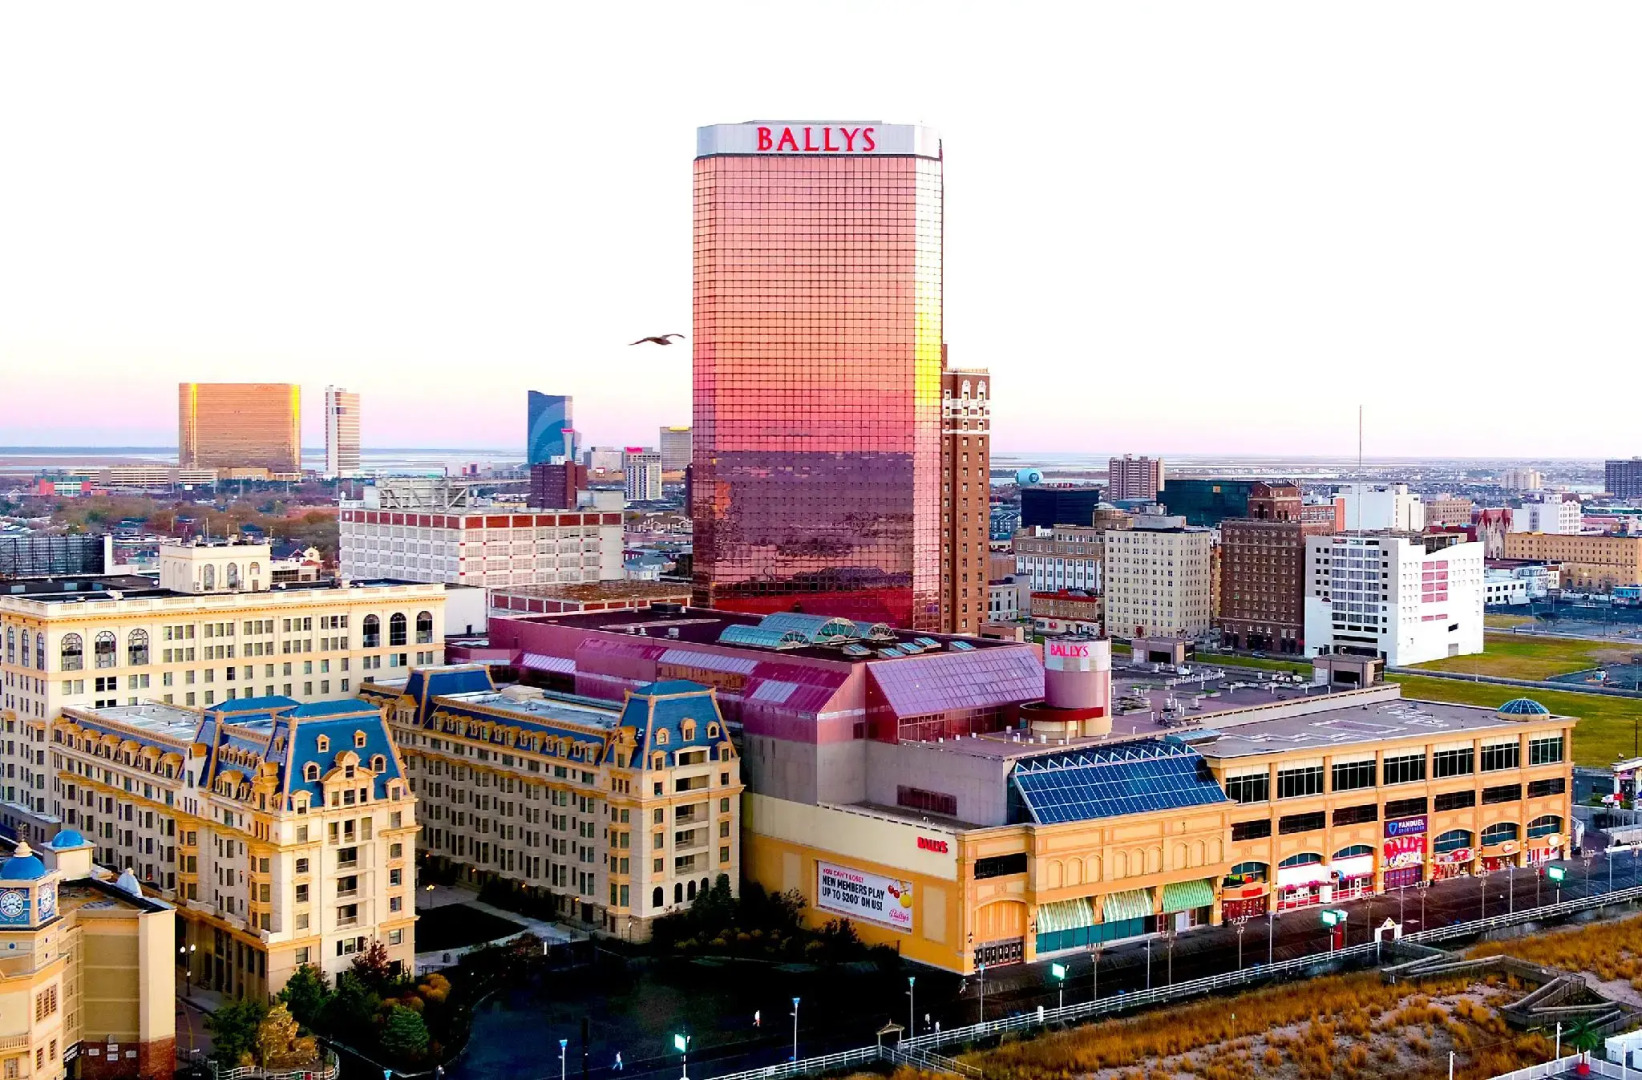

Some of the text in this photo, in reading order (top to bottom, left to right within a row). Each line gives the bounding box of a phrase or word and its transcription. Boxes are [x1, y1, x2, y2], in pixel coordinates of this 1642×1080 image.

[757, 127, 875, 151] BALLYS
[1398, 819, 1424, 828] FANDUEL
[822, 875, 885, 900] NEW MEMBERS PLAY
[833, 870, 848, 878] CAN'T
[849, 874, 864, 883] LOSE!
[822, 886, 831, 897] UP
[832, 889, 840, 900] TO
[861, 897, 870, 907] ON
[871, 901, 883, 911] US!
